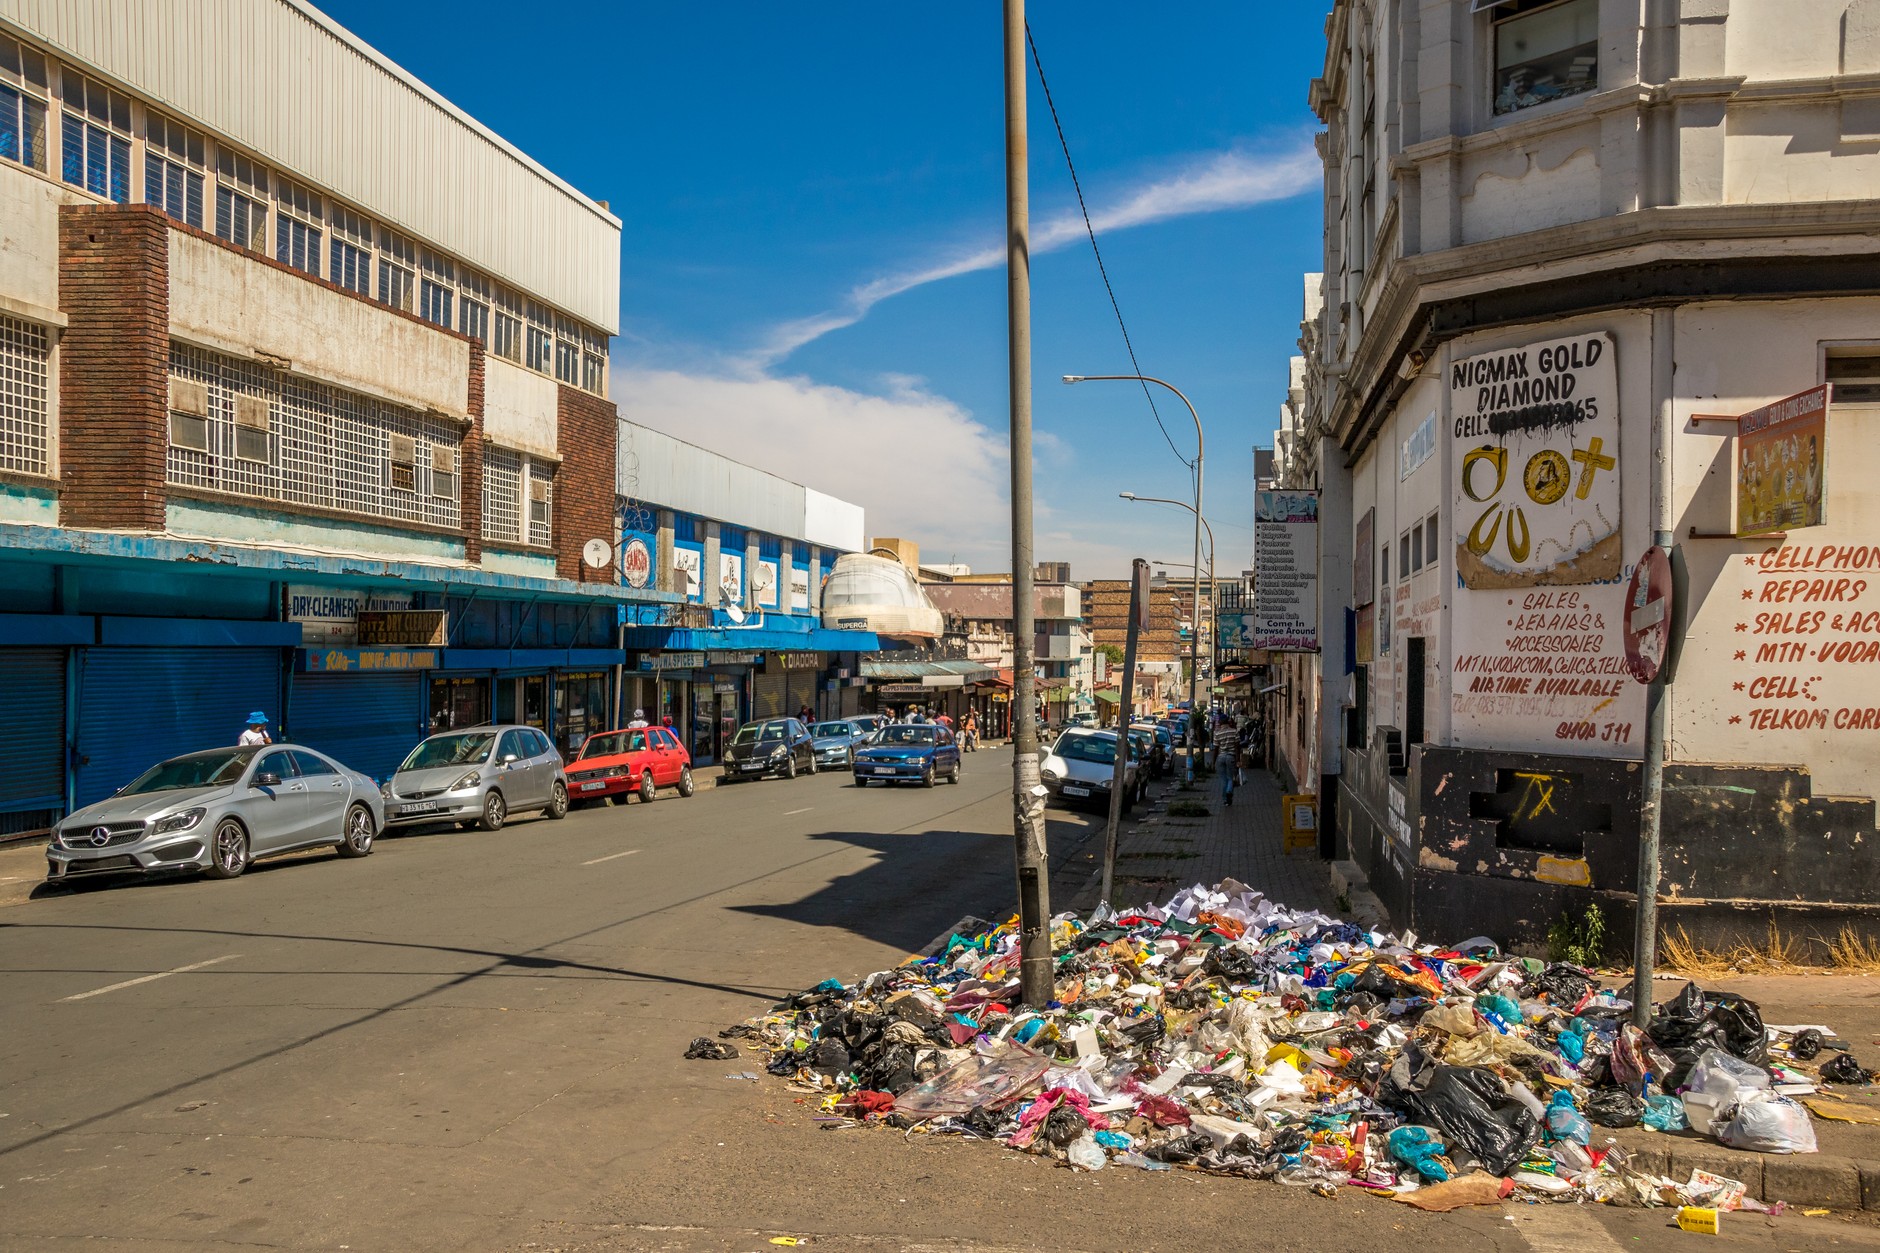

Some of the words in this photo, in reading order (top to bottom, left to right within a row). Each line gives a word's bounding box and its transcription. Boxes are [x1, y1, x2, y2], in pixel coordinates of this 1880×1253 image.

[1452, 351, 1529, 390] NICMAX
[1538, 338, 1602, 374] GOLD
[1477, 372, 1576, 413] DIAMOND
[1454, 414, 1489, 438] CELL:
[1759, 578, 1867, 603] REPAIRS
[359, 620, 385, 632] RITZ
[386, 613, 398, 632] DRY
[837, 621, 868, 630] SUPERGA
[1255, 627, 1284, 635] Browse
[1286, 627, 1316, 635] Around
[1514, 613, 1592, 631] REPAIRS
[1594, 613, 1605, 629] &
[1752, 610, 1826, 635] SALES
[1830, 614, 1843, 631] &
[359, 632, 442, 643] LAUNDRIES
[1268, 635, 1300, 649] Shopping
[1508, 634, 1604, 653] ACCESSORIES
[359, 652, 375, 668] DROP
[375, 652, 385, 668] OFF
[672, 653, 695, 667] SPICES
[788, 653, 819, 668] DIADORA
[1755, 641, 1807, 663] MTN
[1817, 641, 1880, 663] VODA
[1468, 675, 1532, 694] AIRTIME
[1533, 677, 1625, 698] AVAILABLE
[1749, 676, 1799, 699] CELL
[1749, 708, 1830, 730] TELKOM
[1554, 721, 1597, 740] SHOP
[1601, 722, 1632, 743] J11
